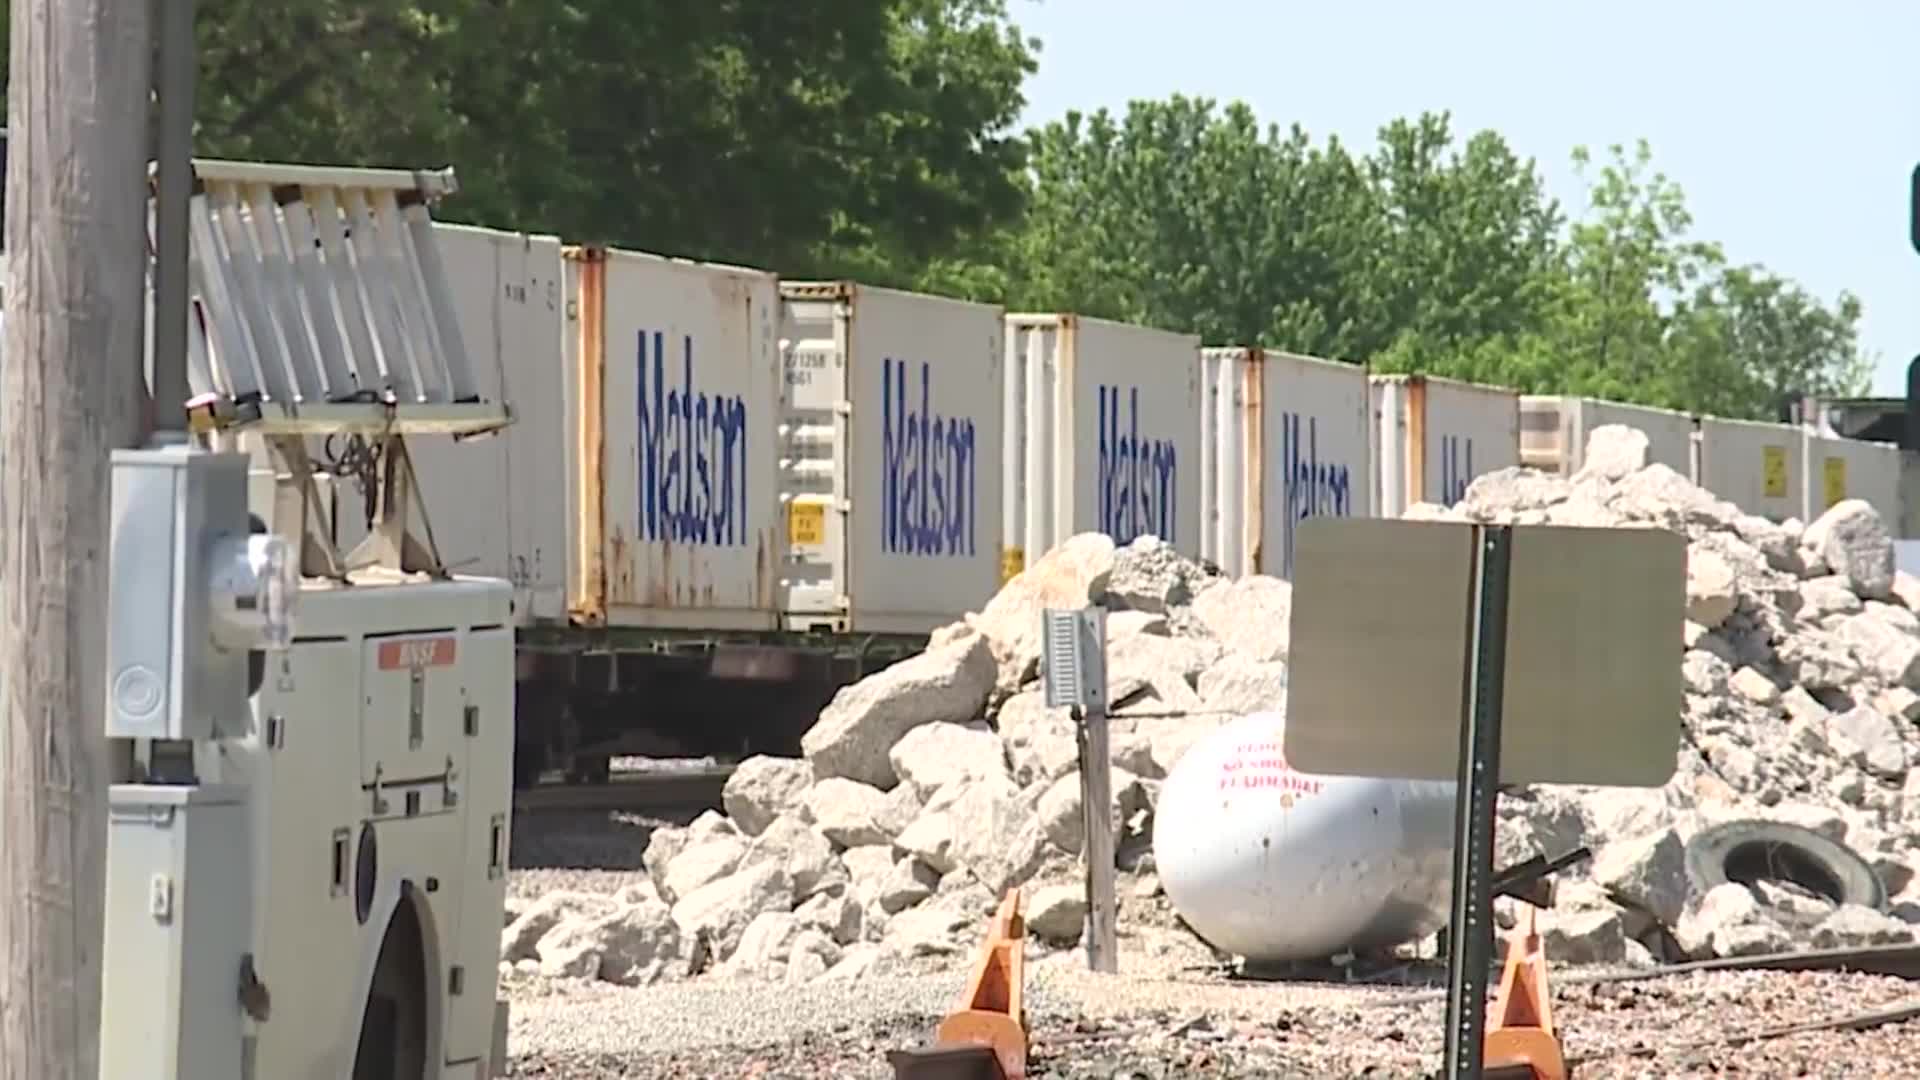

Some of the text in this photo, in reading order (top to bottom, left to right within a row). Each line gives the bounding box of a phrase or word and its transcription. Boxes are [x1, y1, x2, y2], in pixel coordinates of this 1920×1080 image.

[638, 329, 745, 546] Matson
[882, 357, 976, 556] Matson
[1098, 384, 1177, 547] Matson
